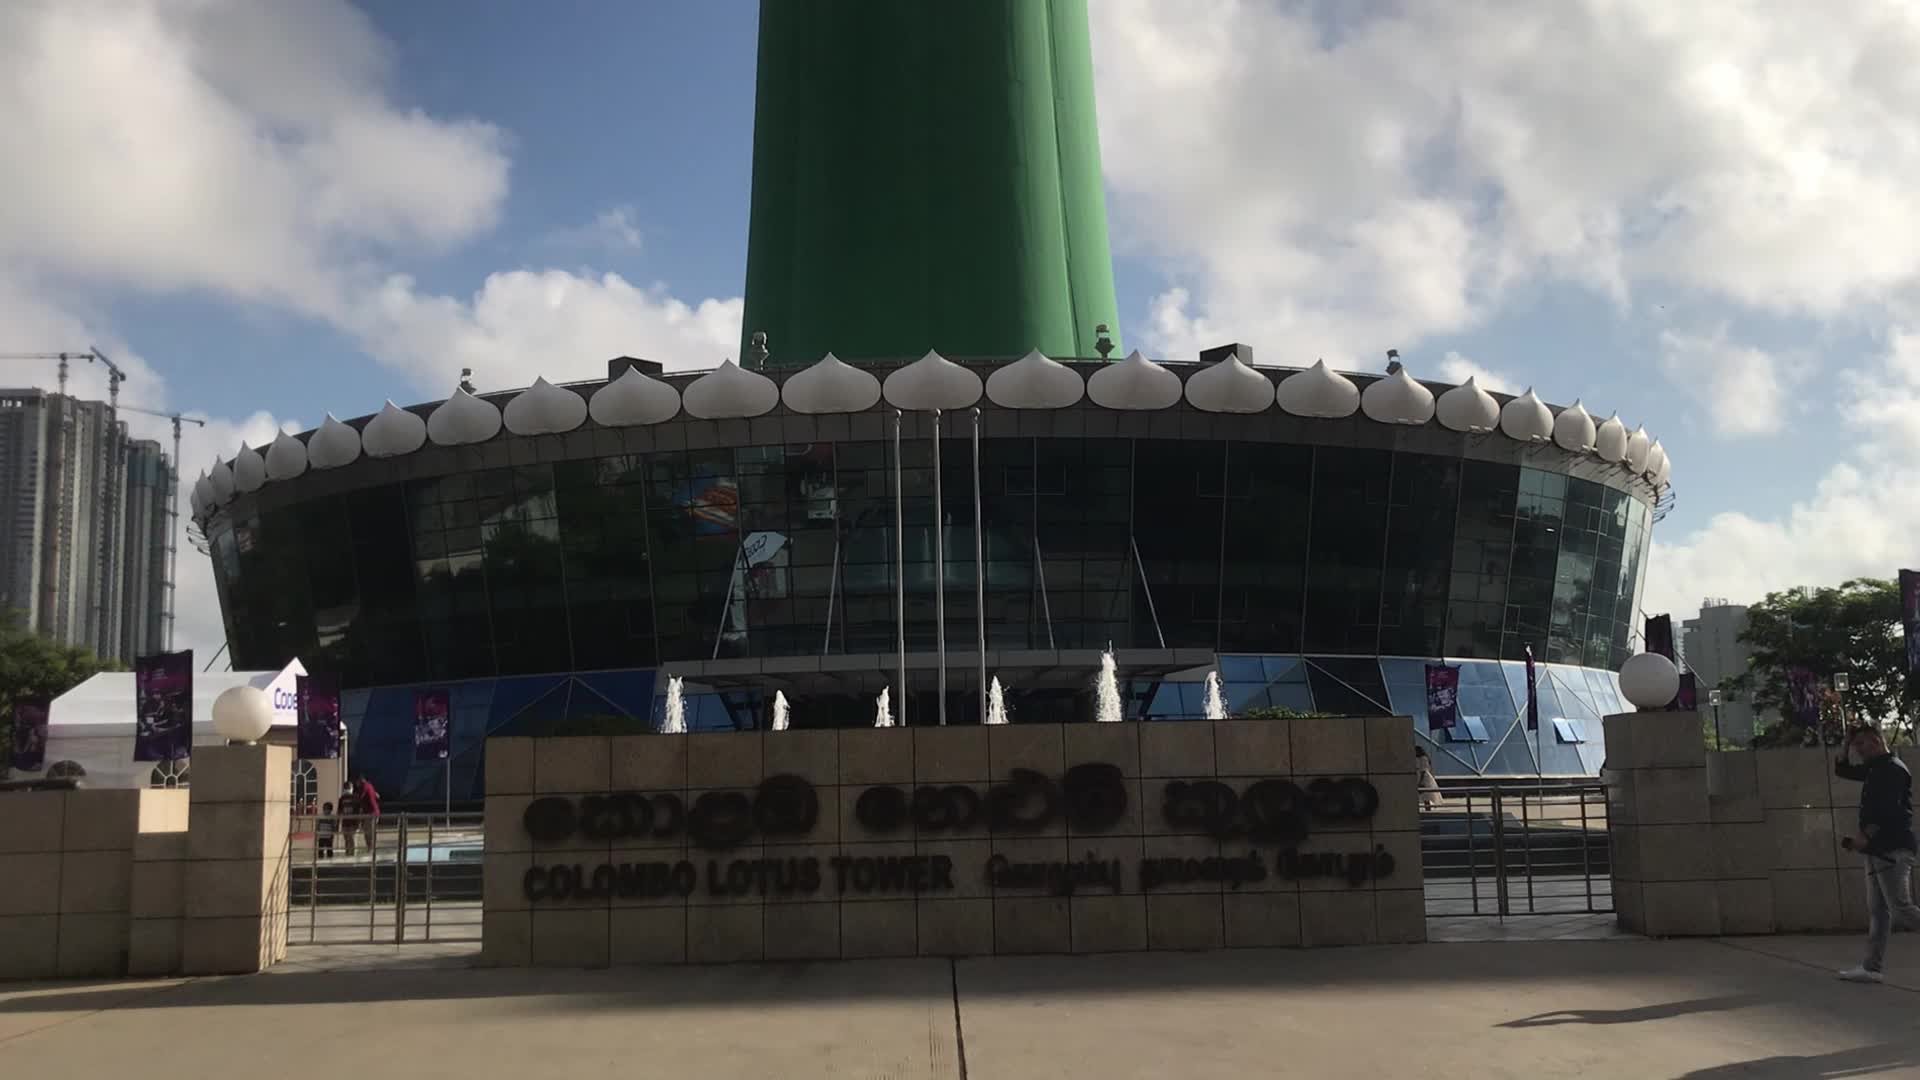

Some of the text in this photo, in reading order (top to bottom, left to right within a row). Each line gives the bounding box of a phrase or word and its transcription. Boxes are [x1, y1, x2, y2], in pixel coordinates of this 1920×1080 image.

[523, 854, 953, 902] COLOMBO LOTUS TOWER
